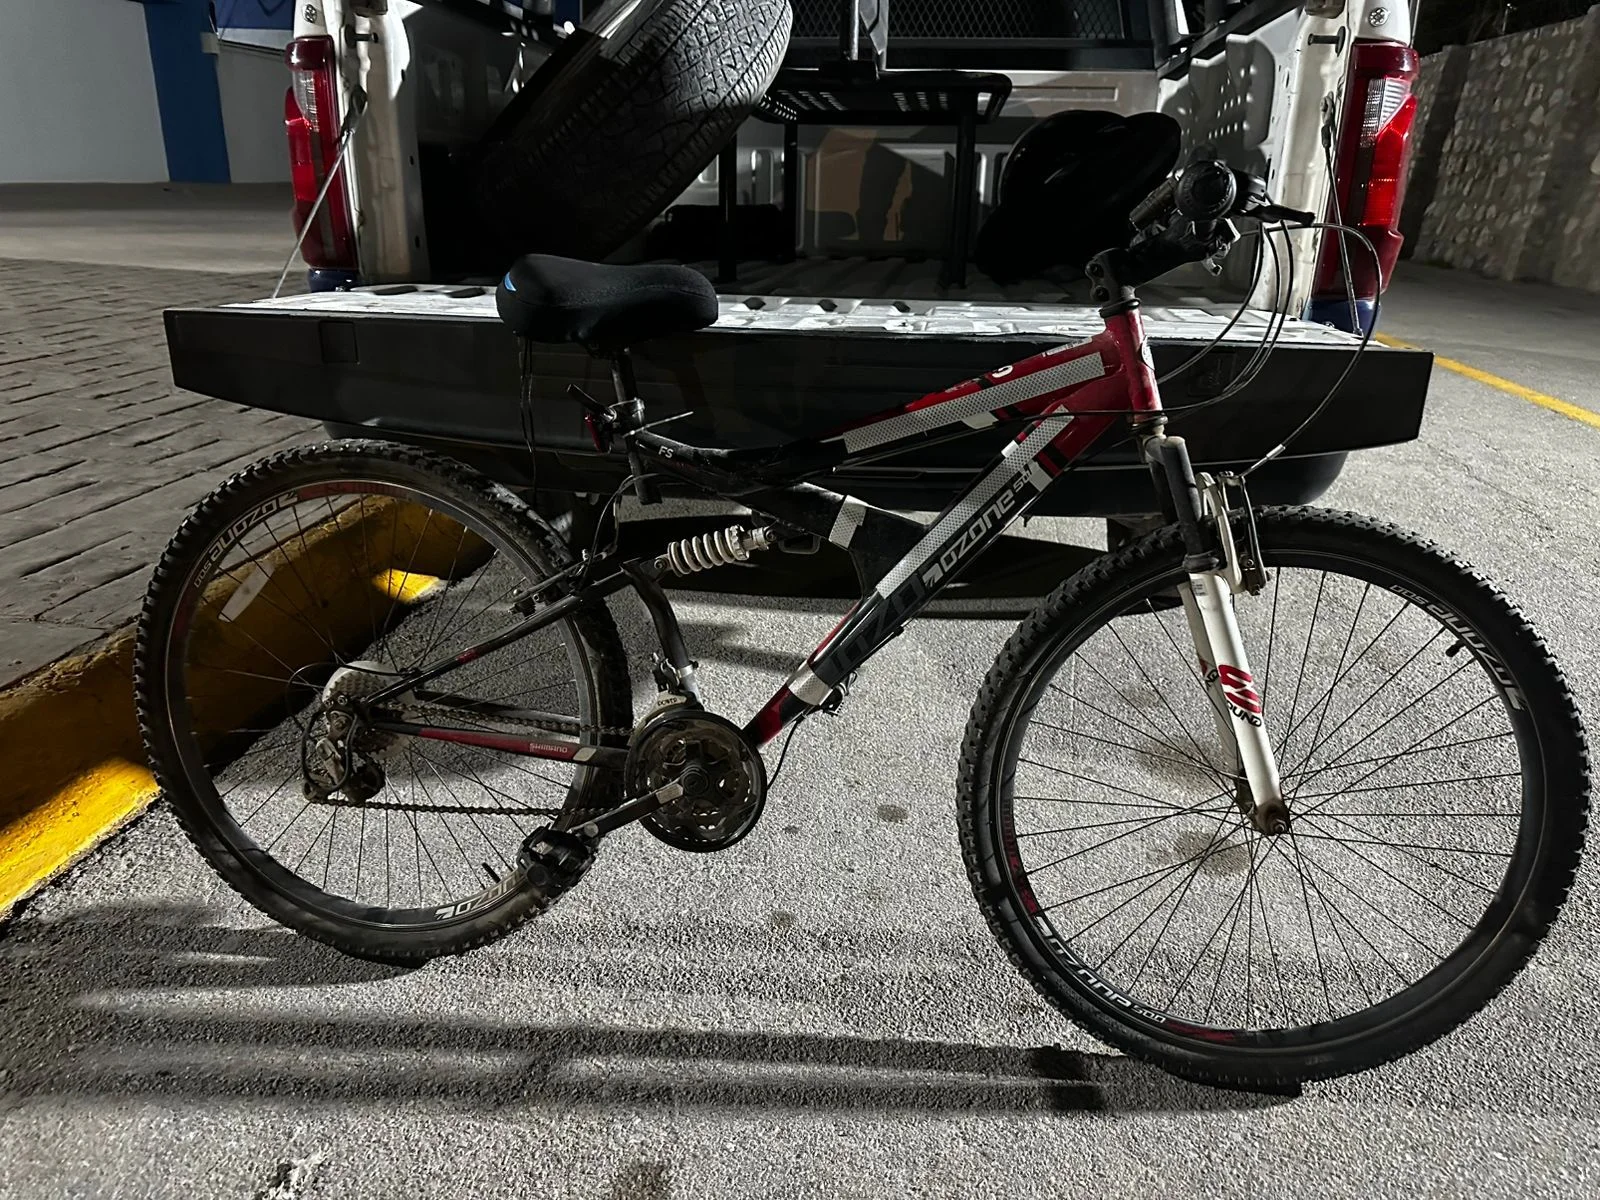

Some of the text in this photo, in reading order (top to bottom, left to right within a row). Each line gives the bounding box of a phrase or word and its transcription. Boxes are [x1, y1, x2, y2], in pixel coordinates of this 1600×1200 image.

[658, 445, 674, 459] FS
[529, 741, 568, 754] SHIMANO
[1130, 1004, 1167, 1024] 500
